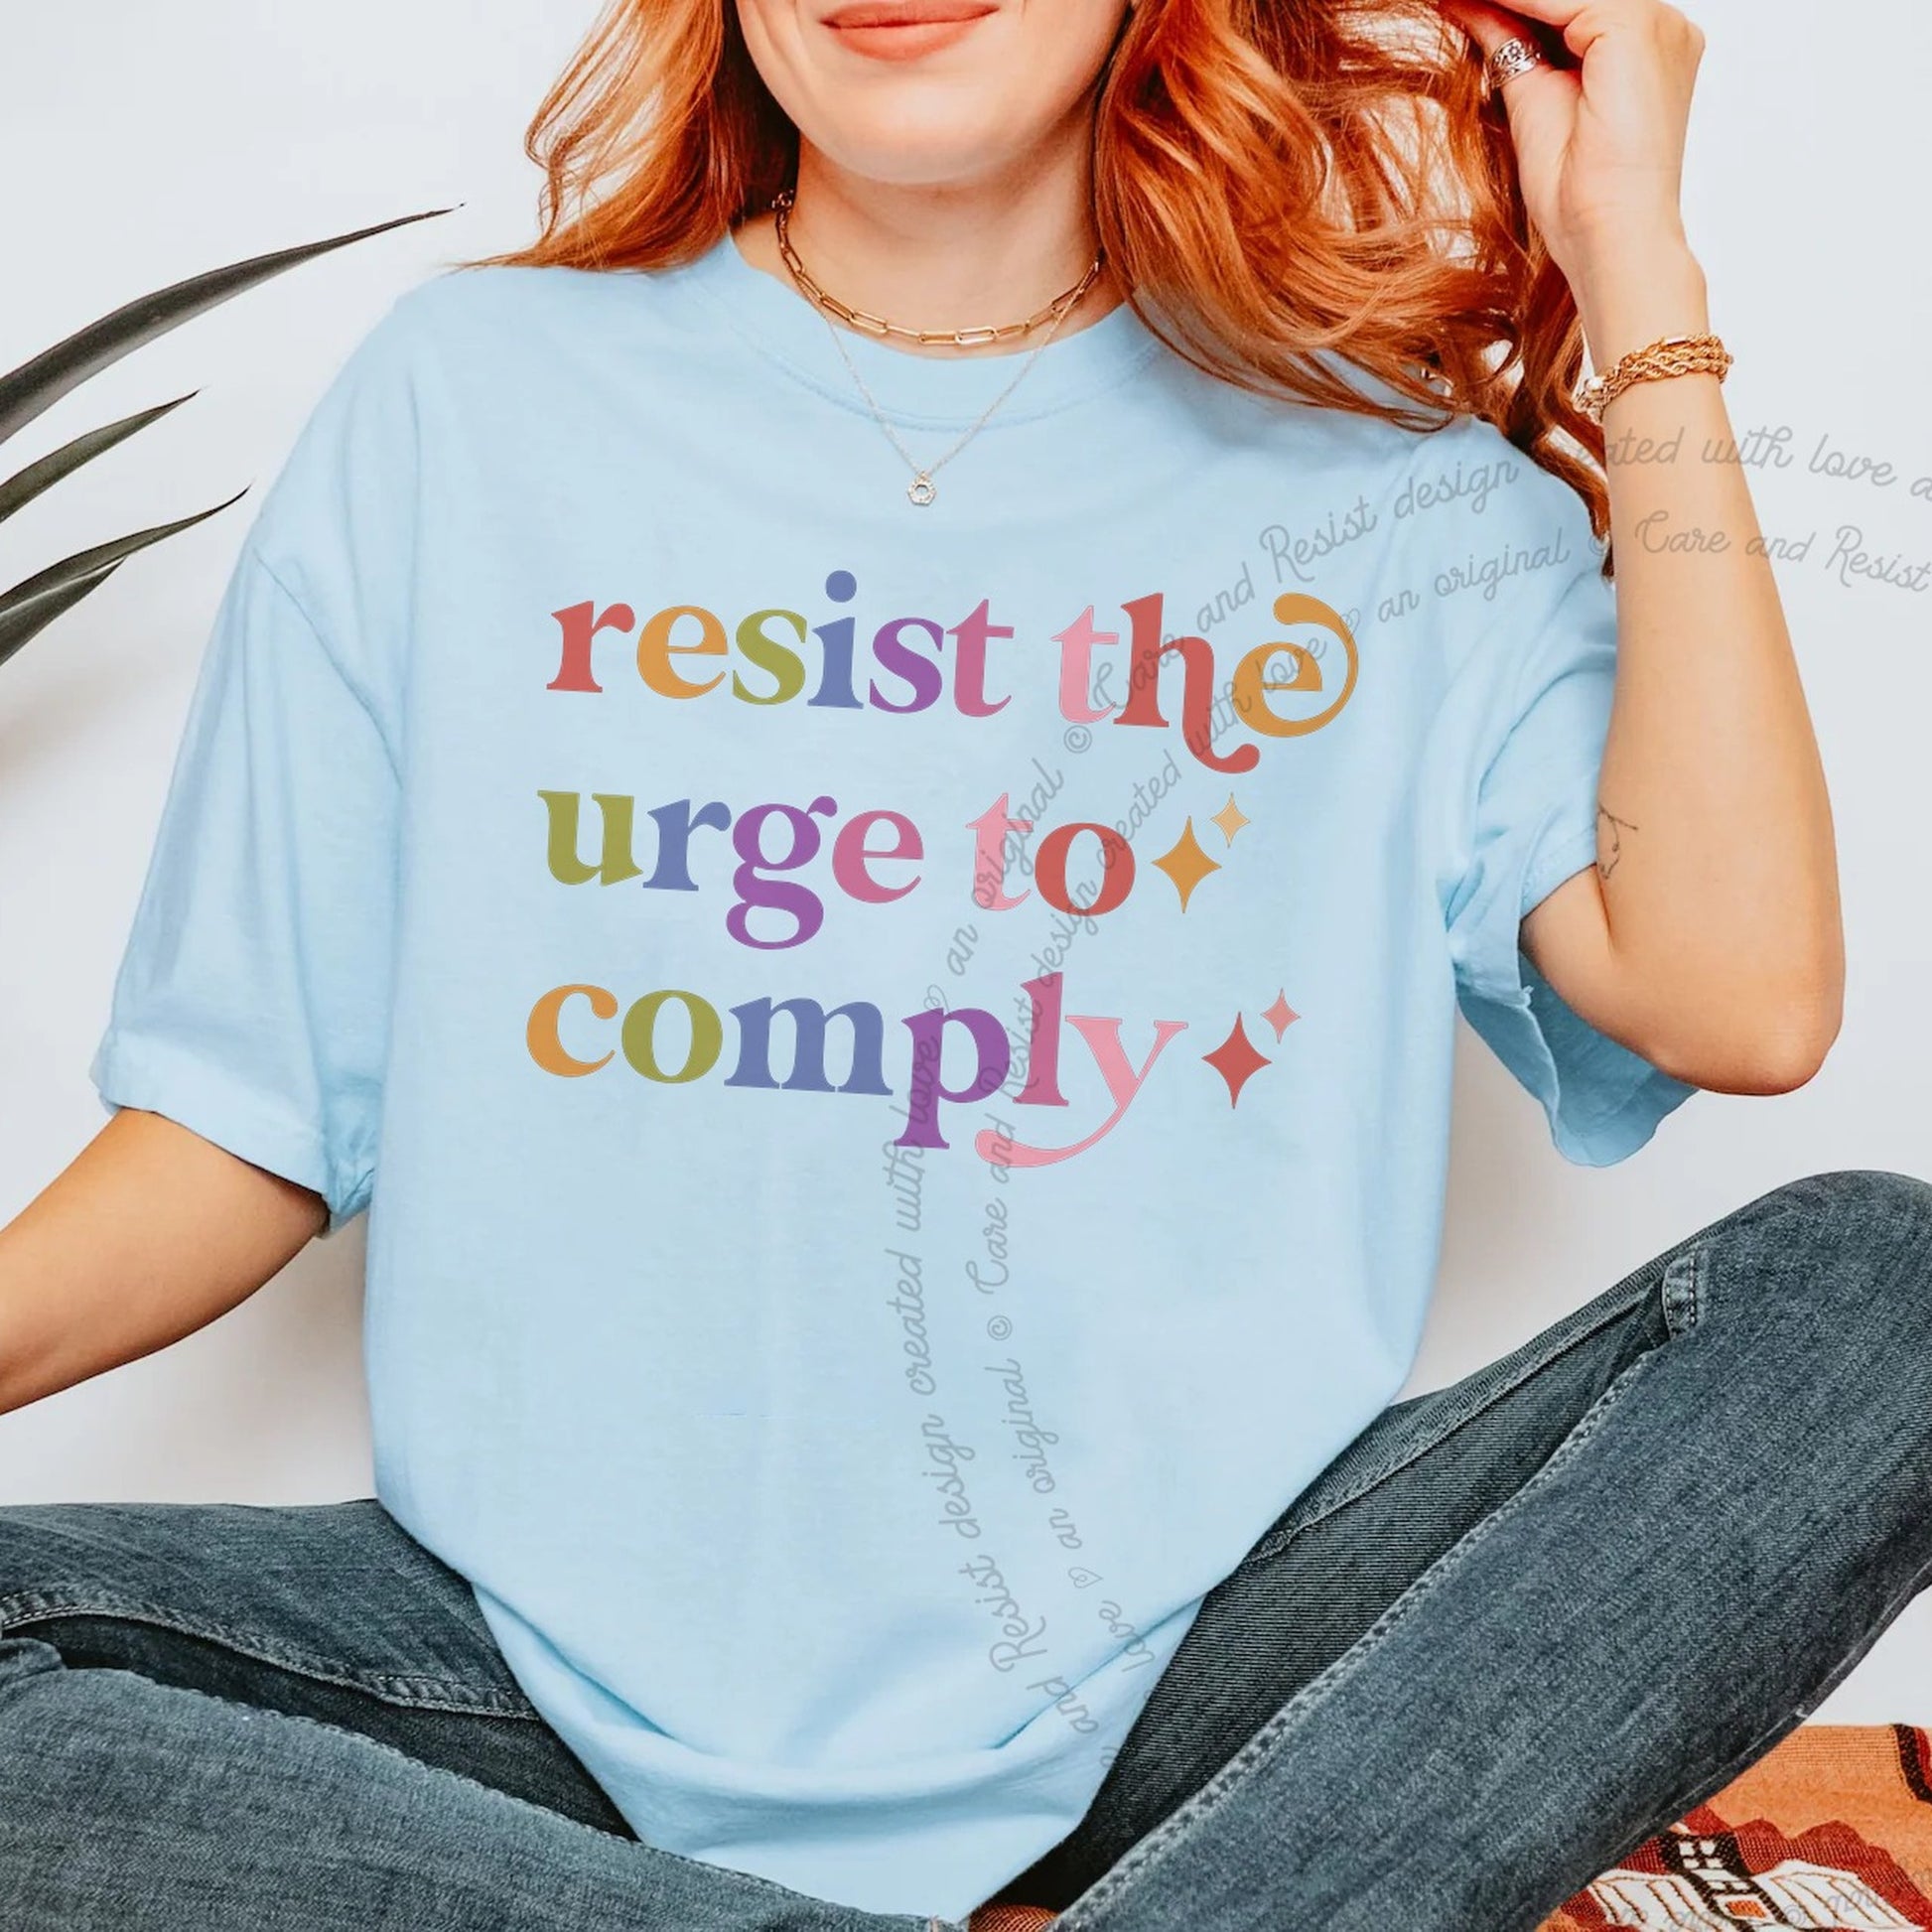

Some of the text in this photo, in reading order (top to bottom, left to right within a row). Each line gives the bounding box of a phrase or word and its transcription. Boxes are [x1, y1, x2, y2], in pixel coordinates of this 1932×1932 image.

[545, 570, 1360, 774] resist the
[536, 789, 1137, 951] urge to
[525, 971, 1189, 1169] comply
